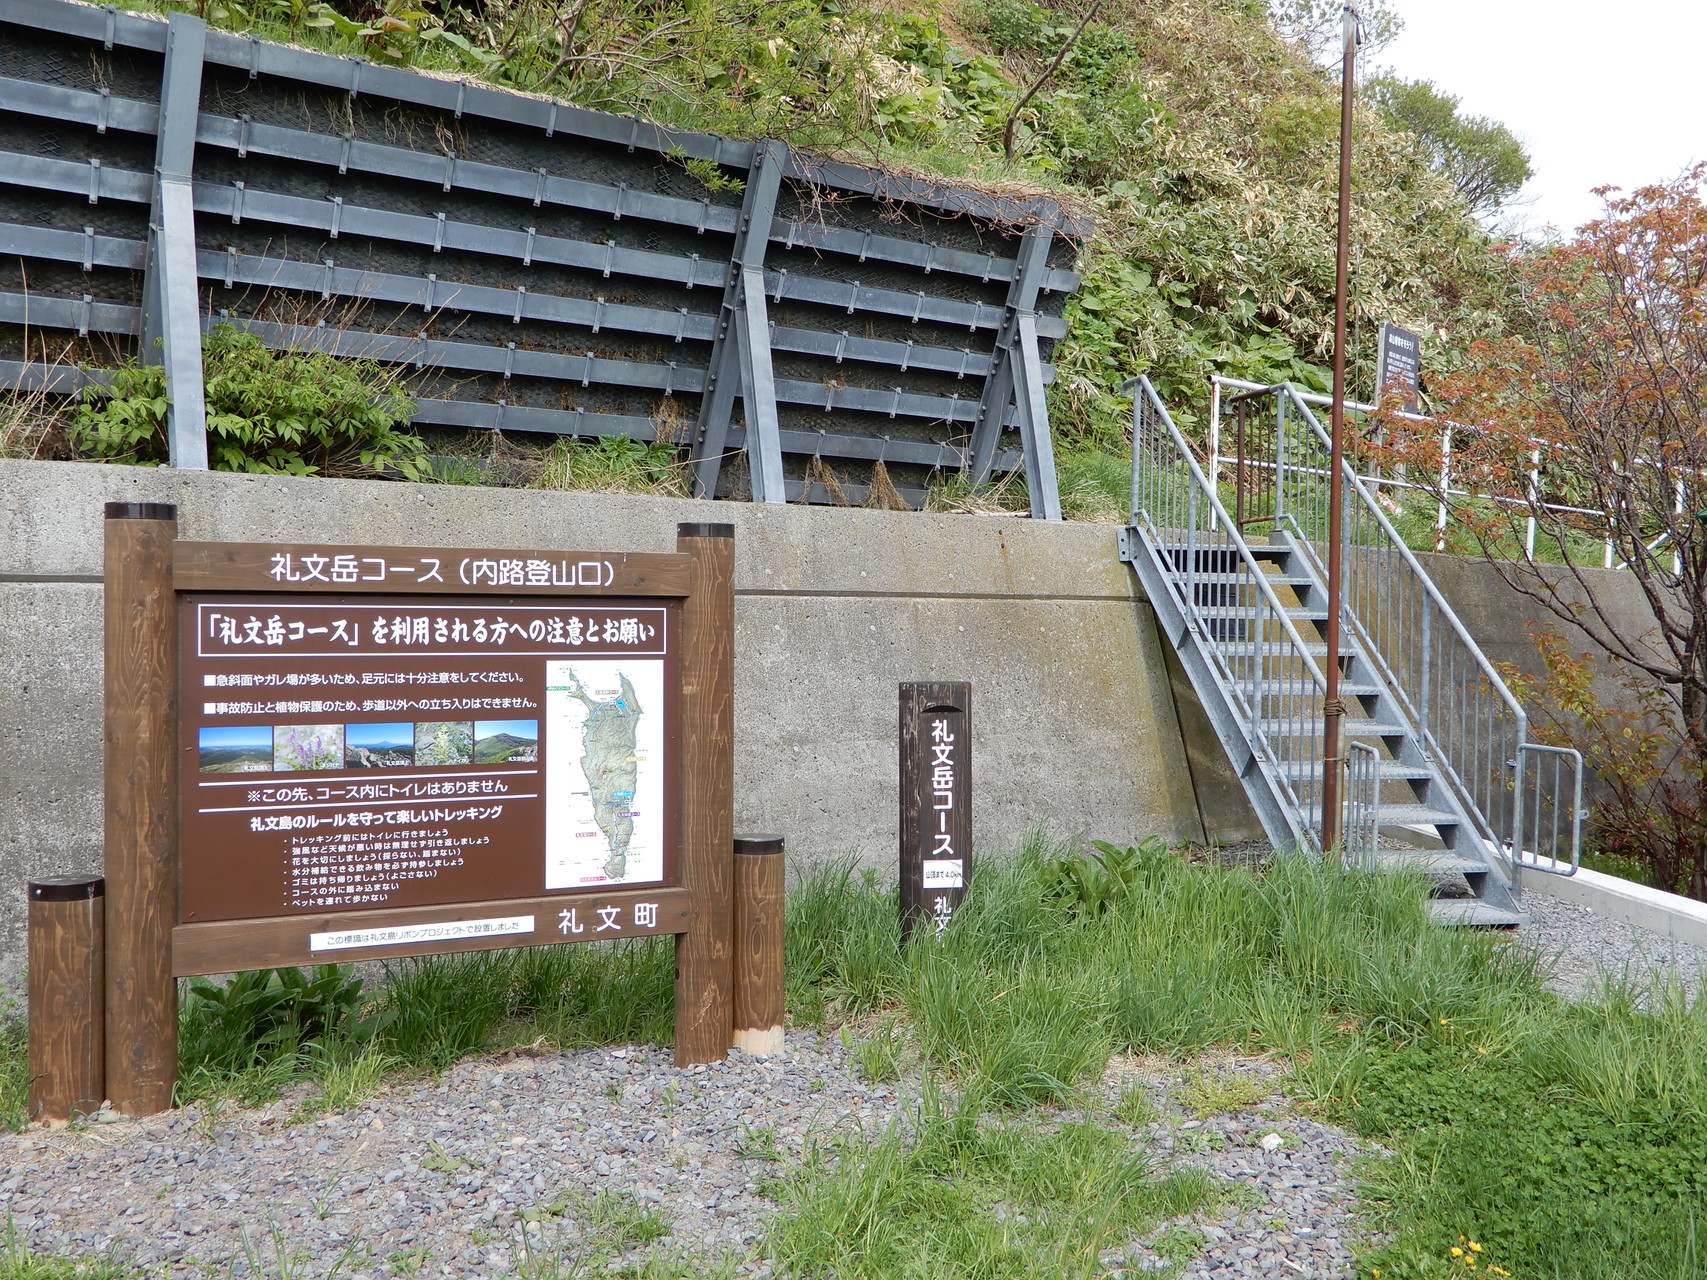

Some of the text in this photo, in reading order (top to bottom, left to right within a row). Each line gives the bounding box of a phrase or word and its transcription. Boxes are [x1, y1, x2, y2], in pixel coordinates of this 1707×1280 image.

[210, 613, 655, 646] 「礼文岳コース」を利用される方への注意とお願い
[931, 719, 955, 855] 礼文岳コース
[250, 805, 503, 832] 礼文島のルールを守って楽しいトレッキング
[558, 902, 659, 935] 礼文町
